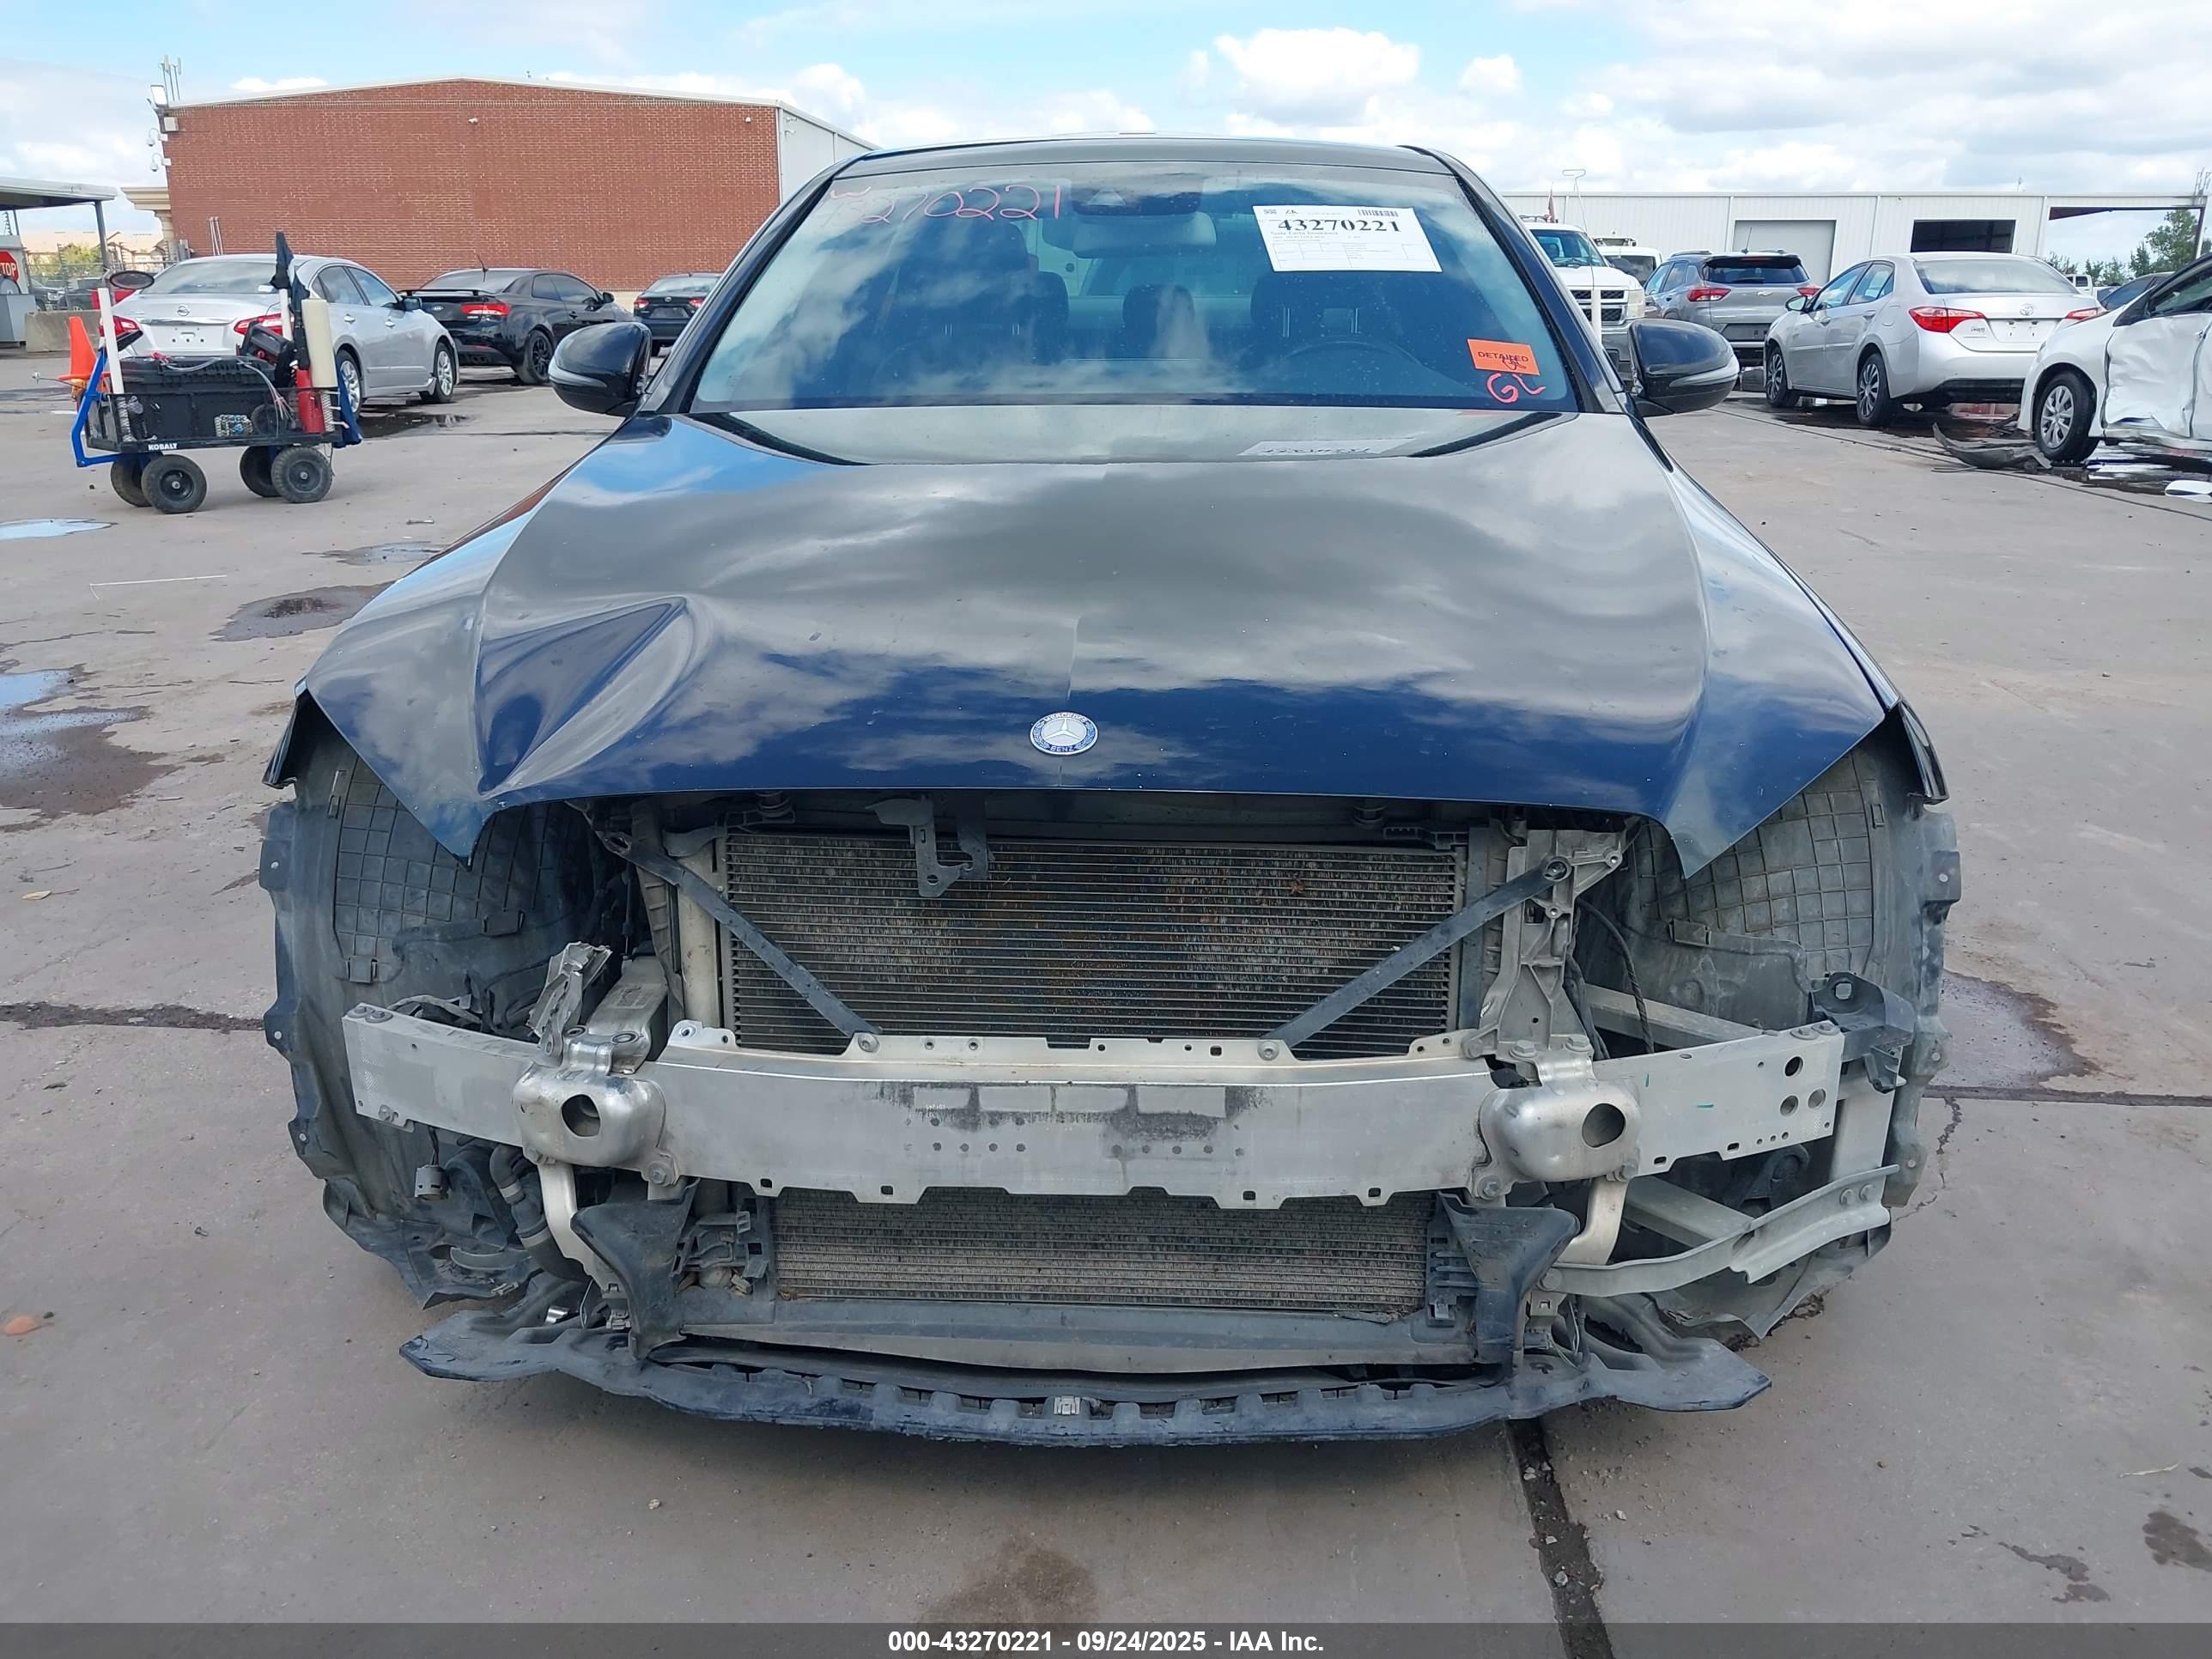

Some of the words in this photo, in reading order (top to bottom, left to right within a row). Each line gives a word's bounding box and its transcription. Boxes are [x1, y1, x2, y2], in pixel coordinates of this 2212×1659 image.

[822, 184, 1061, 225] 270221
[1278, 219, 1401, 232] 43270221
[0, 262, 16, 276] TOP
[1478, 351, 1529, 362] DETAILED
[148, 442, 178, 451] KOBALT
